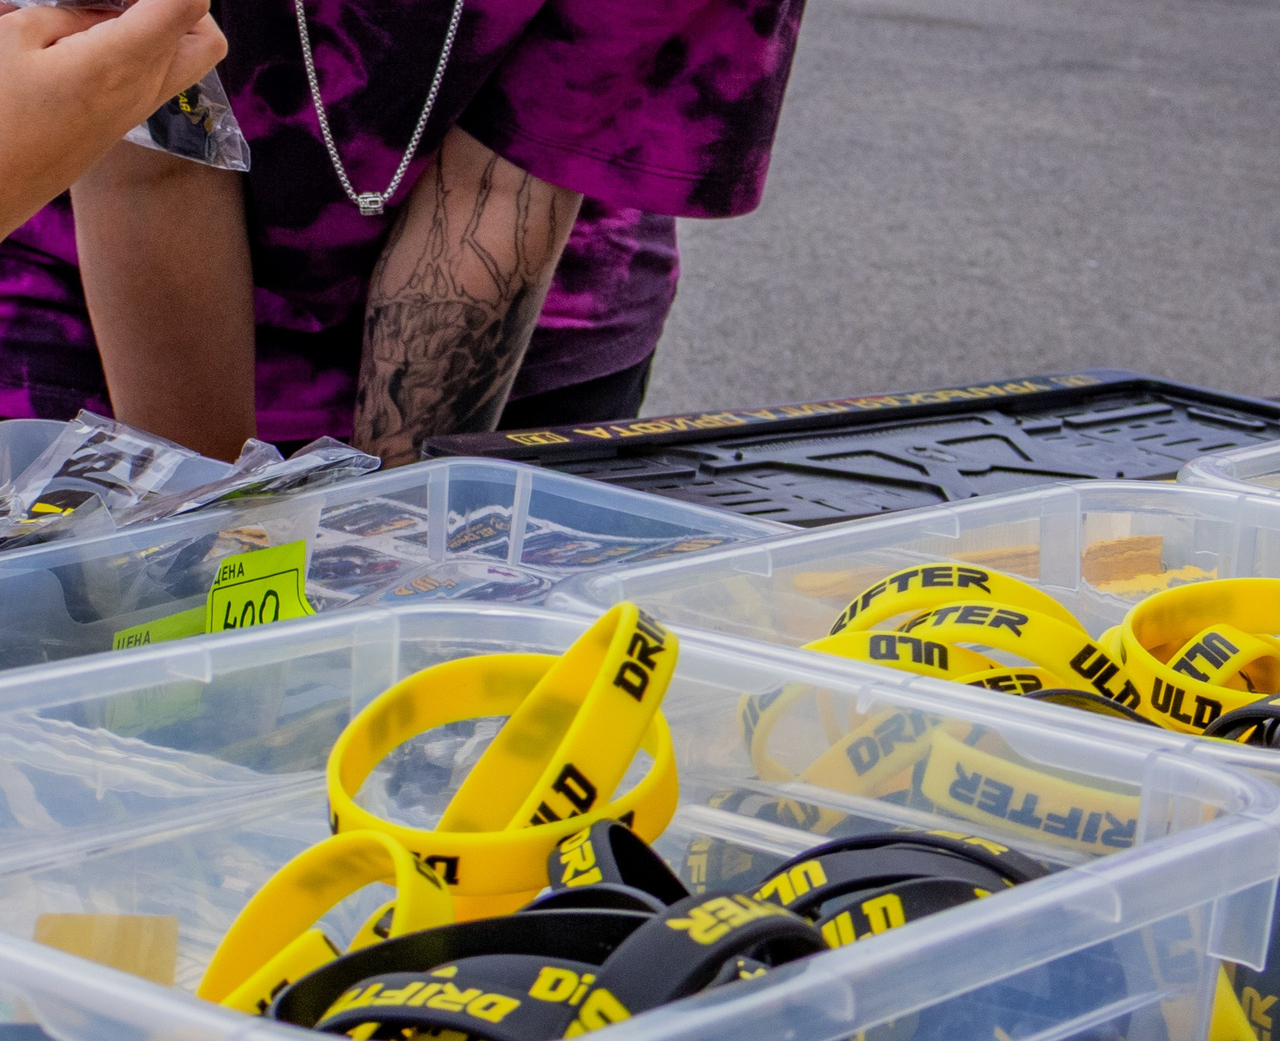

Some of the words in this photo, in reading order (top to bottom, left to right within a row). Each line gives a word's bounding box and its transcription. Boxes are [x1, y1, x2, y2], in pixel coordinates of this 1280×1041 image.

[830, 566, 992, 636] RIFTER
[869, 634, 949, 671] ULD
[1150, 676, 1223, 730] ULD
[948, 761, 1138, 849] RIFTER
